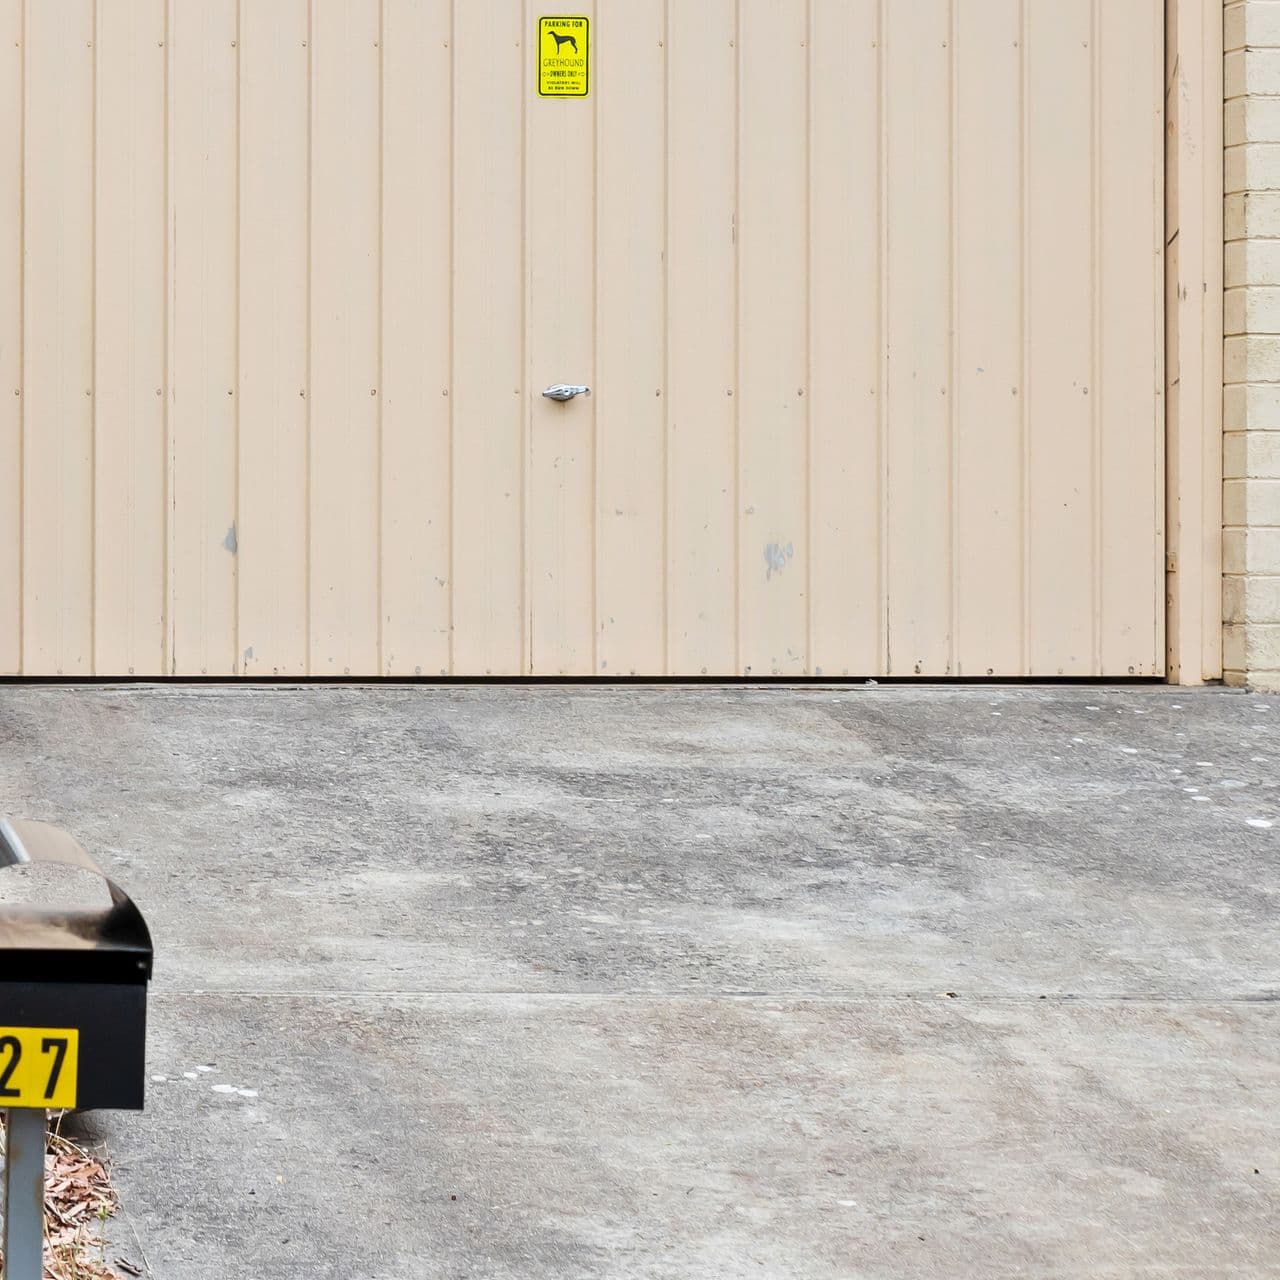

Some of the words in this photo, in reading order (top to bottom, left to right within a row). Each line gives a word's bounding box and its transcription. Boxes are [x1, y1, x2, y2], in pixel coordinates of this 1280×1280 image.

[544, 20, 571, 28] PARKING
[571, 20, 583, 28] FOR
[543, 58, 584, 67] GREYHOUND
[550, 70, 567, 78] OWNERS
